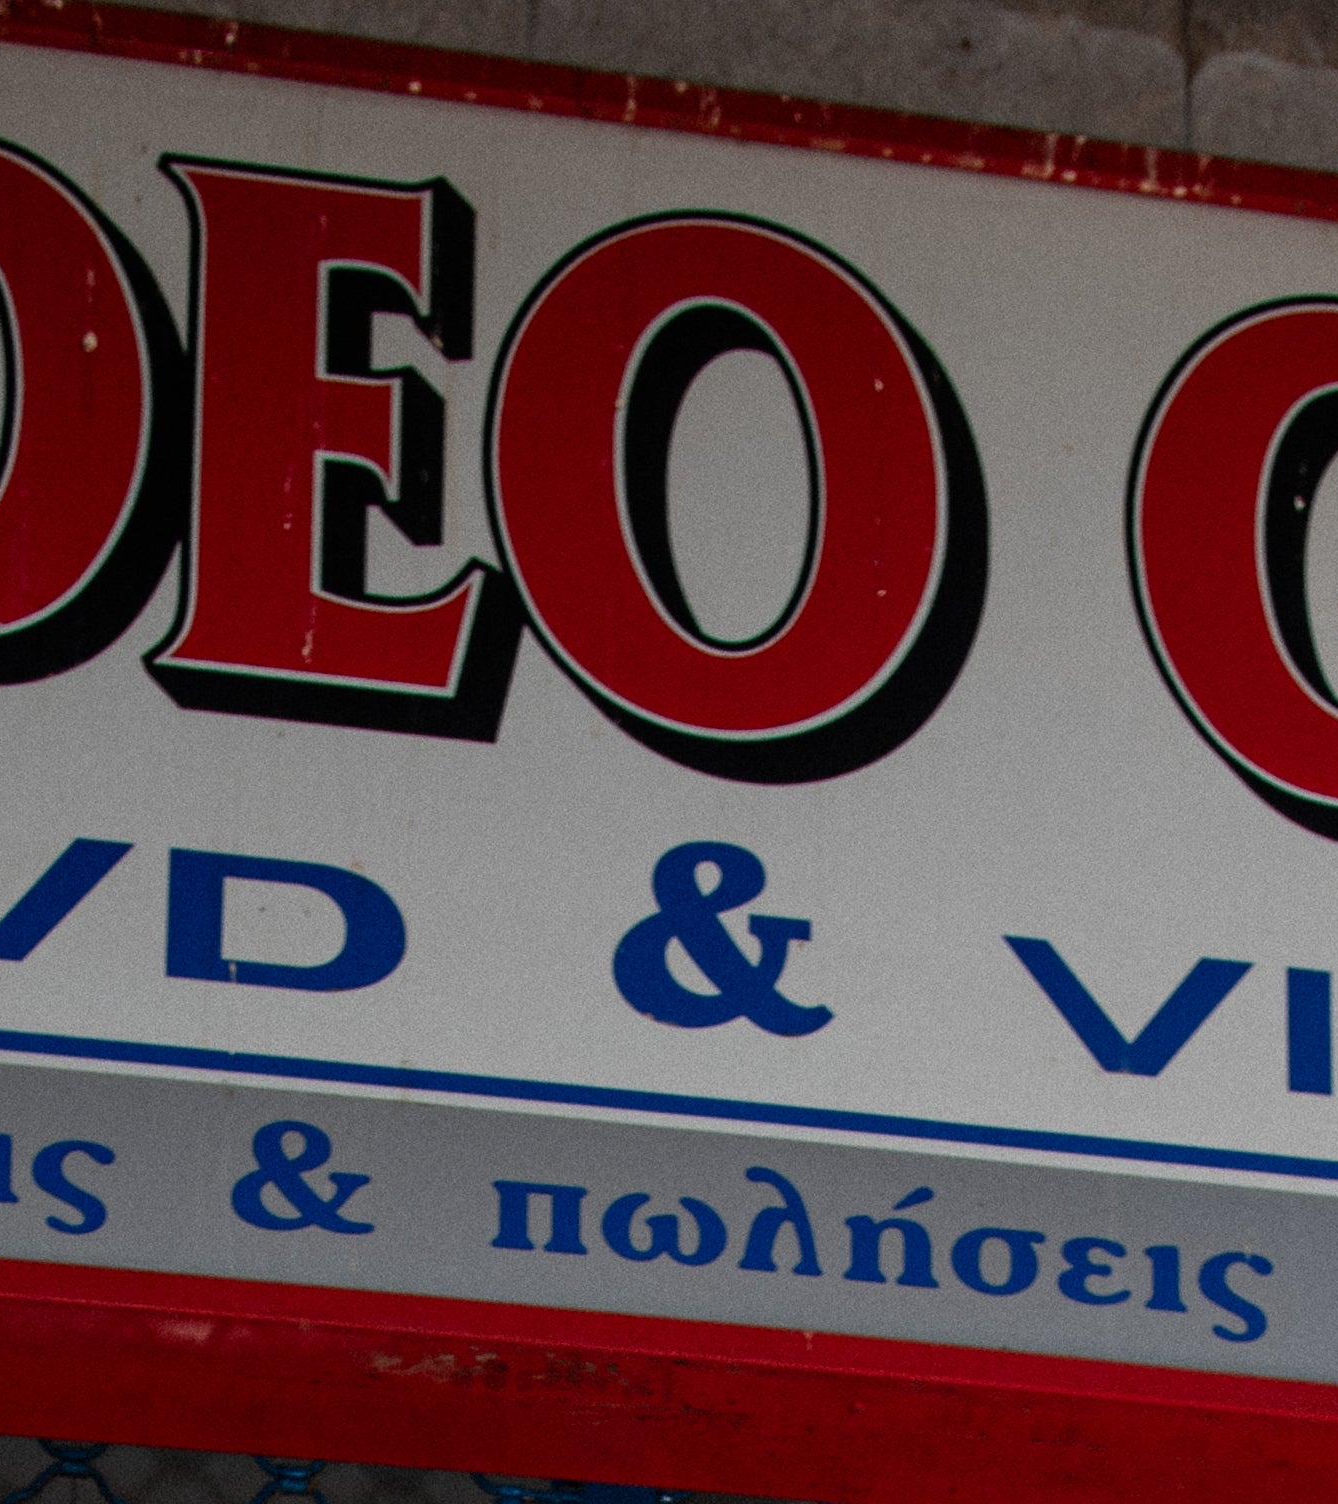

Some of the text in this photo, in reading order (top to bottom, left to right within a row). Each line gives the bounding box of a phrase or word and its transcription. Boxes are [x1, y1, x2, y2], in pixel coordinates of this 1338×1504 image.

[613, 841, 833, 1035] &
[231, 1120, 374, 1234] &
[491, 1166, 1273, 1342] πωλήσεις
